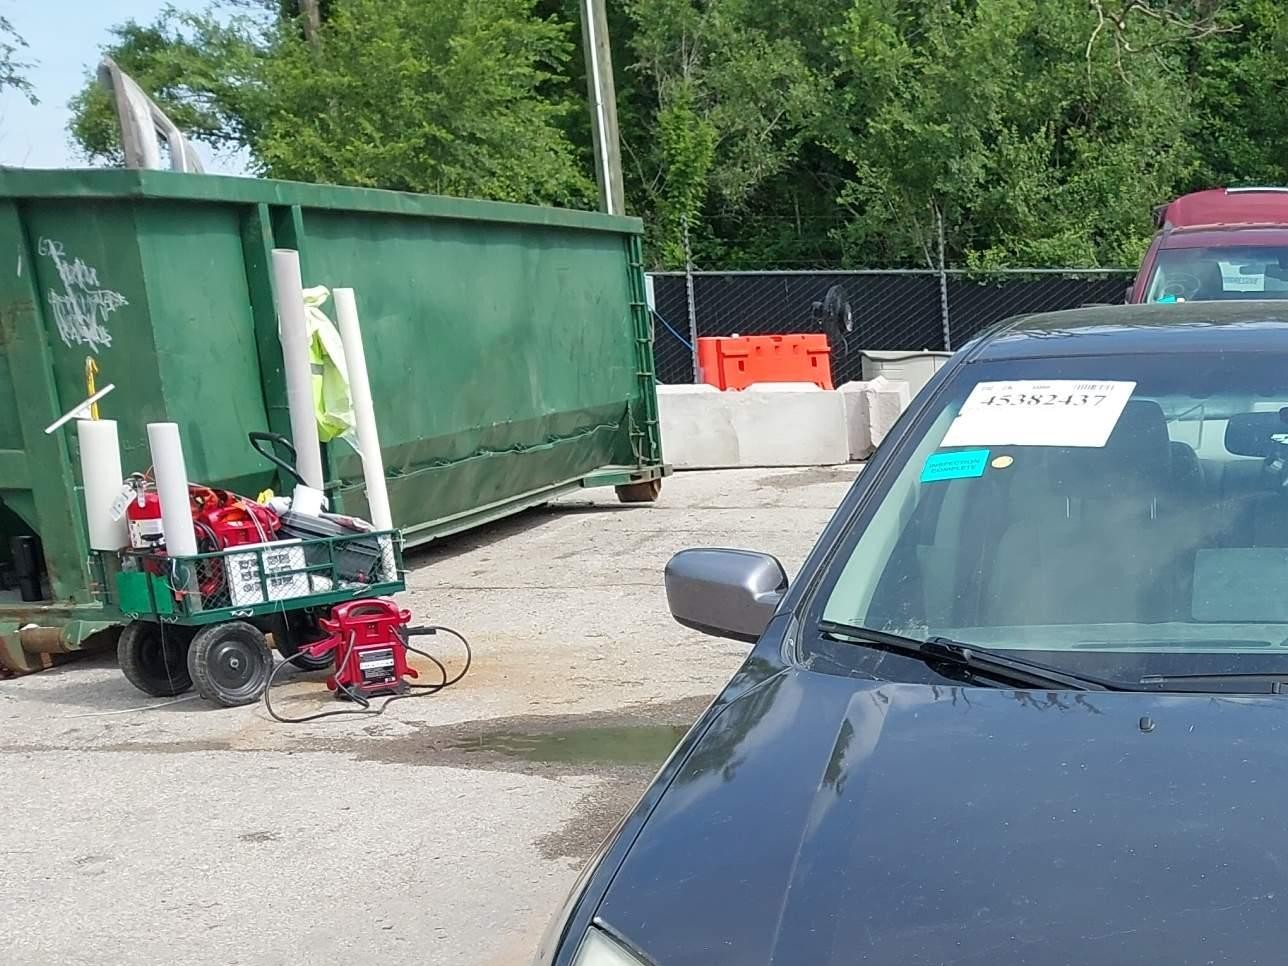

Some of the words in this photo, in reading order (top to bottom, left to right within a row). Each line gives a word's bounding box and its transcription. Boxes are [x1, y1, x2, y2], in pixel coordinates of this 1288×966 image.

[981, 394, 1107, 406] 45382437
[930, 459, 980, 468] INSPECTION
[930, 465, 976, 473] COMPLETE
